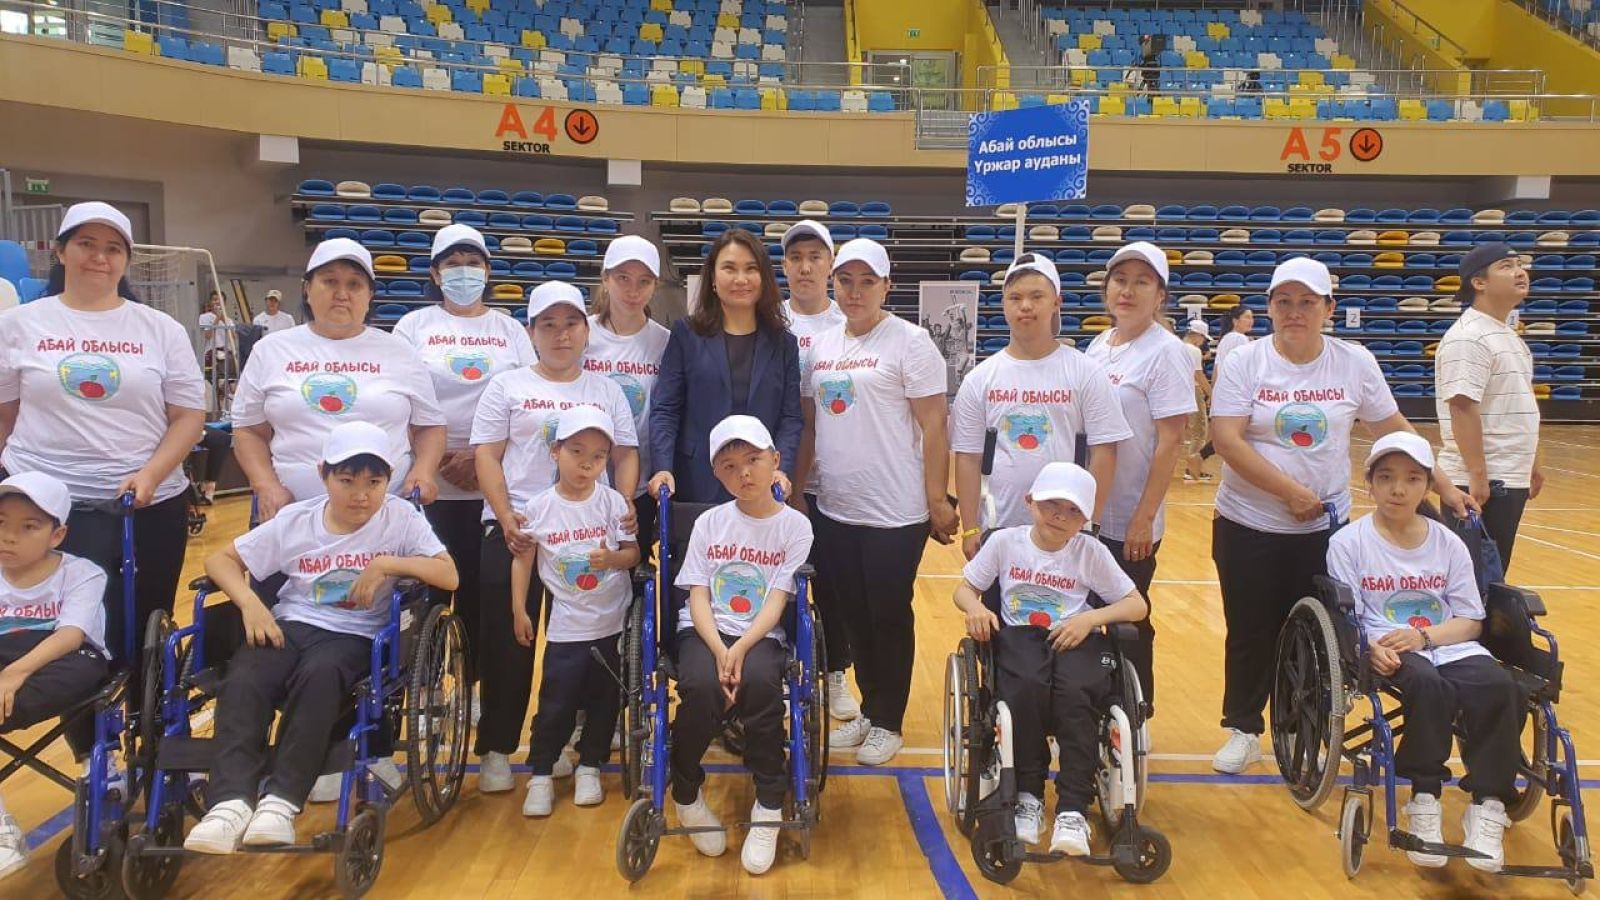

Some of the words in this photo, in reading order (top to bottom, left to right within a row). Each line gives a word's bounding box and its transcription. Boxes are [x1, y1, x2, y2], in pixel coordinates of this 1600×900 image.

[503, 141, 550, 153] SEKTOR
[979, 138, 1014, 154] Абай
[1018, 134, 1077, 150] облысы
[975, 159, 1020, 175] Үржар
[1024, 153, 1081, 171] ауданы
[1288, 163, 1332, 172] SEKTOR
[37, 338, 75, 352] АБАЙ
[81, 339, 143, 355] ОБЛЫСЫ
[428, 335, 456, 345] АБАЙ
[460, 336, 507, 347] ОБЛЫСЫ
[286, 361, 319, 373] АБАЙ
[324, 362, 380, 373] ОБЛЫСЫ
[583, 359, 612, 372] АБАЙ
[988, 389, 1017, 403] АБАЙ
[1022, 389, 1072, 403] ОБЛЫСЫ
[1258, 388, 1289, 402] АБАЙ
[1293, 387, 1345, 402] ОБЛЫСЫ
[523, 399, 555, 410] АБАЙ
[548, 530, 571, 544] АБАЙ
[707, 544, 737, 560] АБАЙ
[299, 555, 331, 573] АБАЙ
[1009, 564, 1032, 583] АБАЙ
[1034, 572, 1076, 590] ОБЛЫСЫ
[1361, 575, 1395, 591] АБАЙ
